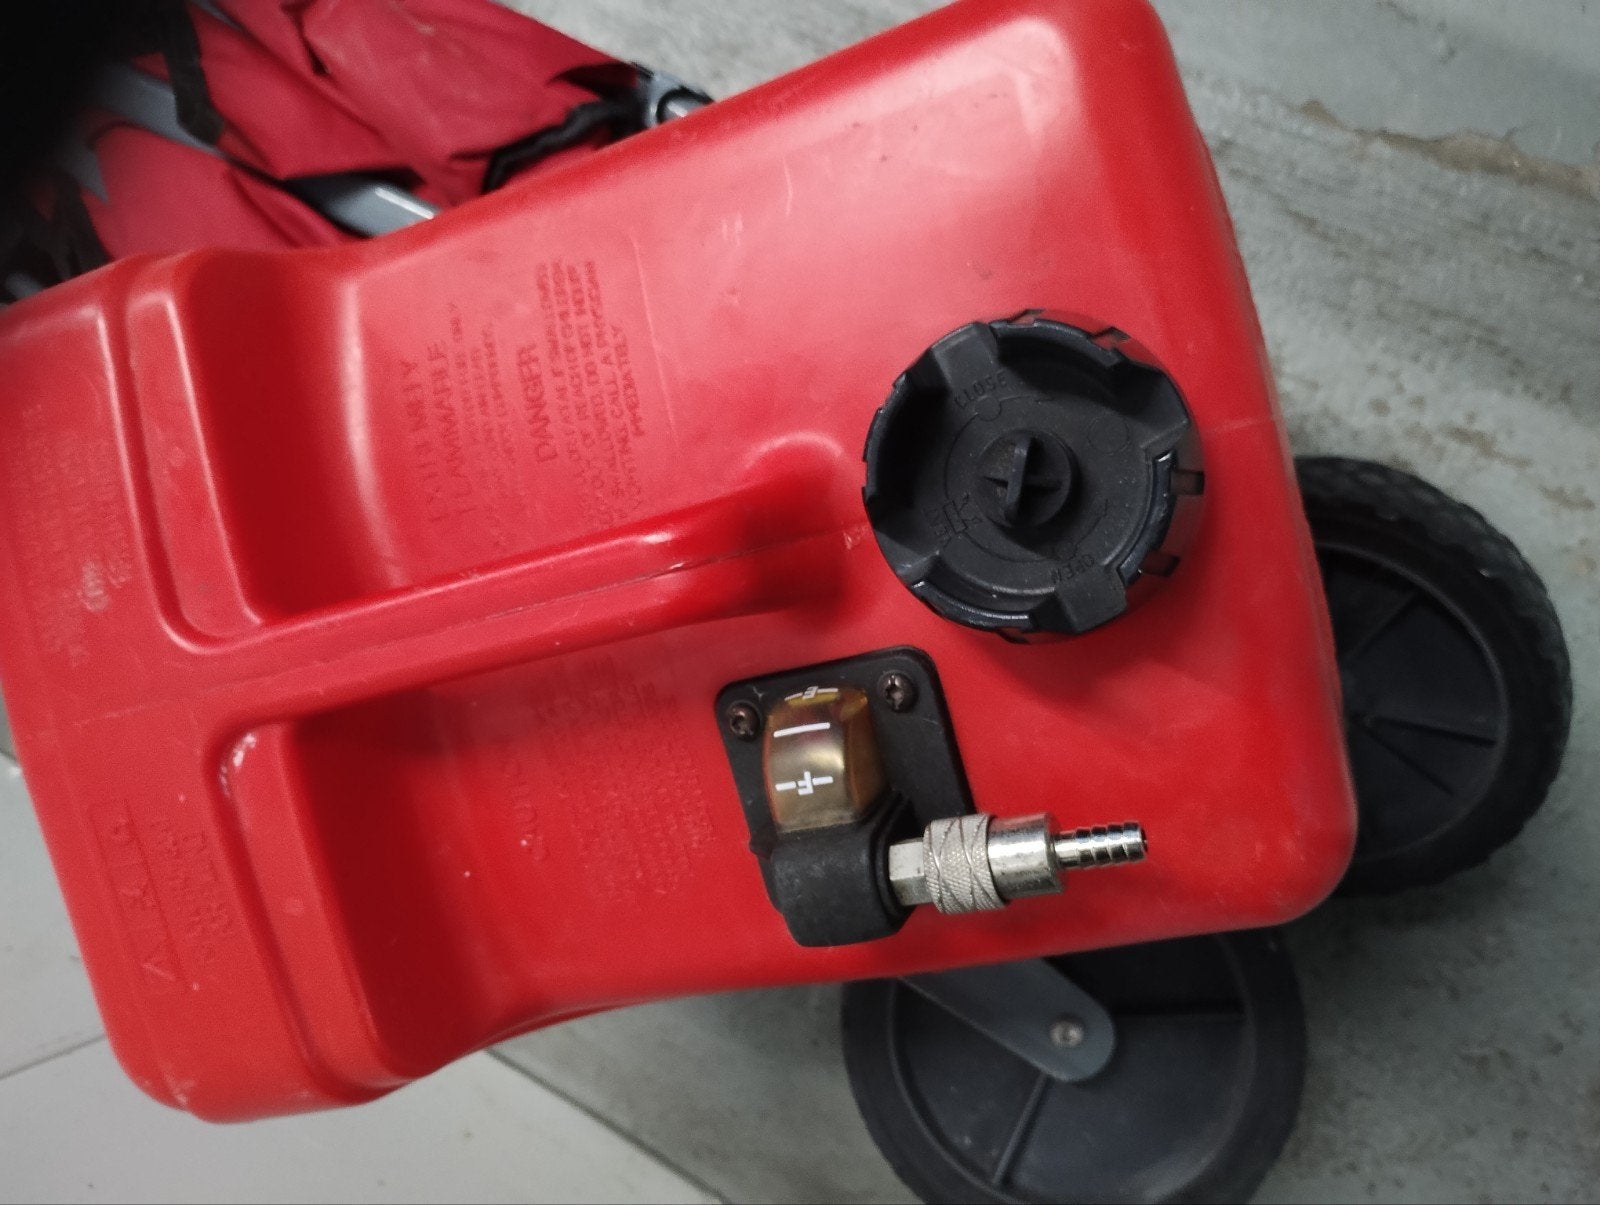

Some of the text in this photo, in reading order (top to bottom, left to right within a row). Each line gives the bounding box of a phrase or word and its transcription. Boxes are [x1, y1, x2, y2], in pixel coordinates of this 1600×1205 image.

[513, 342, 558, 463] DANGER
[952, 369, 1007, 409] CLOSE
[1051, 553, 1096, 585] OPEN
